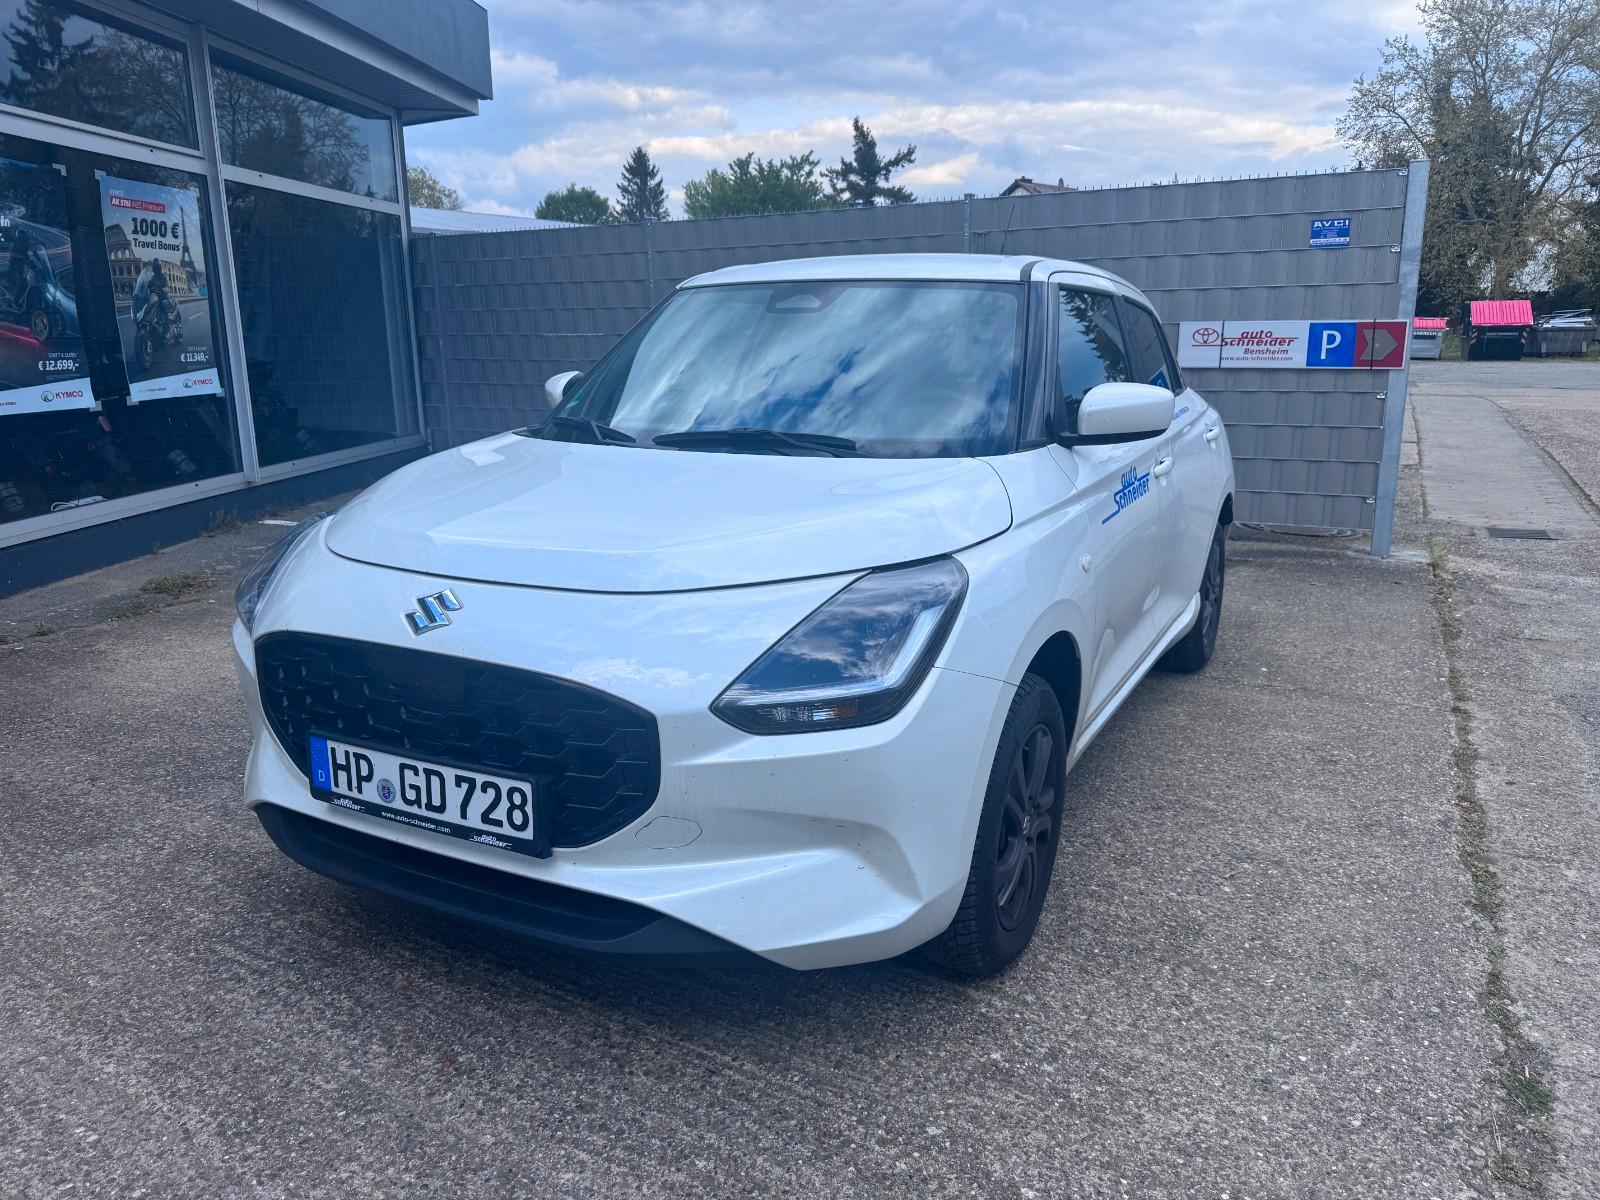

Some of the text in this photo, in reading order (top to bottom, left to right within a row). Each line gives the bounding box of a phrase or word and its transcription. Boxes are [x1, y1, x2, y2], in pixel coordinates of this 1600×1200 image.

[132, 217, 179, 239] 1000 €
[133, 238, 157, 250] Travel
[1241, 330, 1273, 339] auto
[1320, 330, 1341, 360] P
[193, 378, 214, 386] KYMCO
[55, 391, 84, 400] KYMCO
[1121, 465, 1138, 487] auto
[318, 769, 325, 782] D
[330, 746, 375, 795] HP
[455, 773, 530, 832] 728
[381, 811, 451, 834] www.auto-schneider.com
